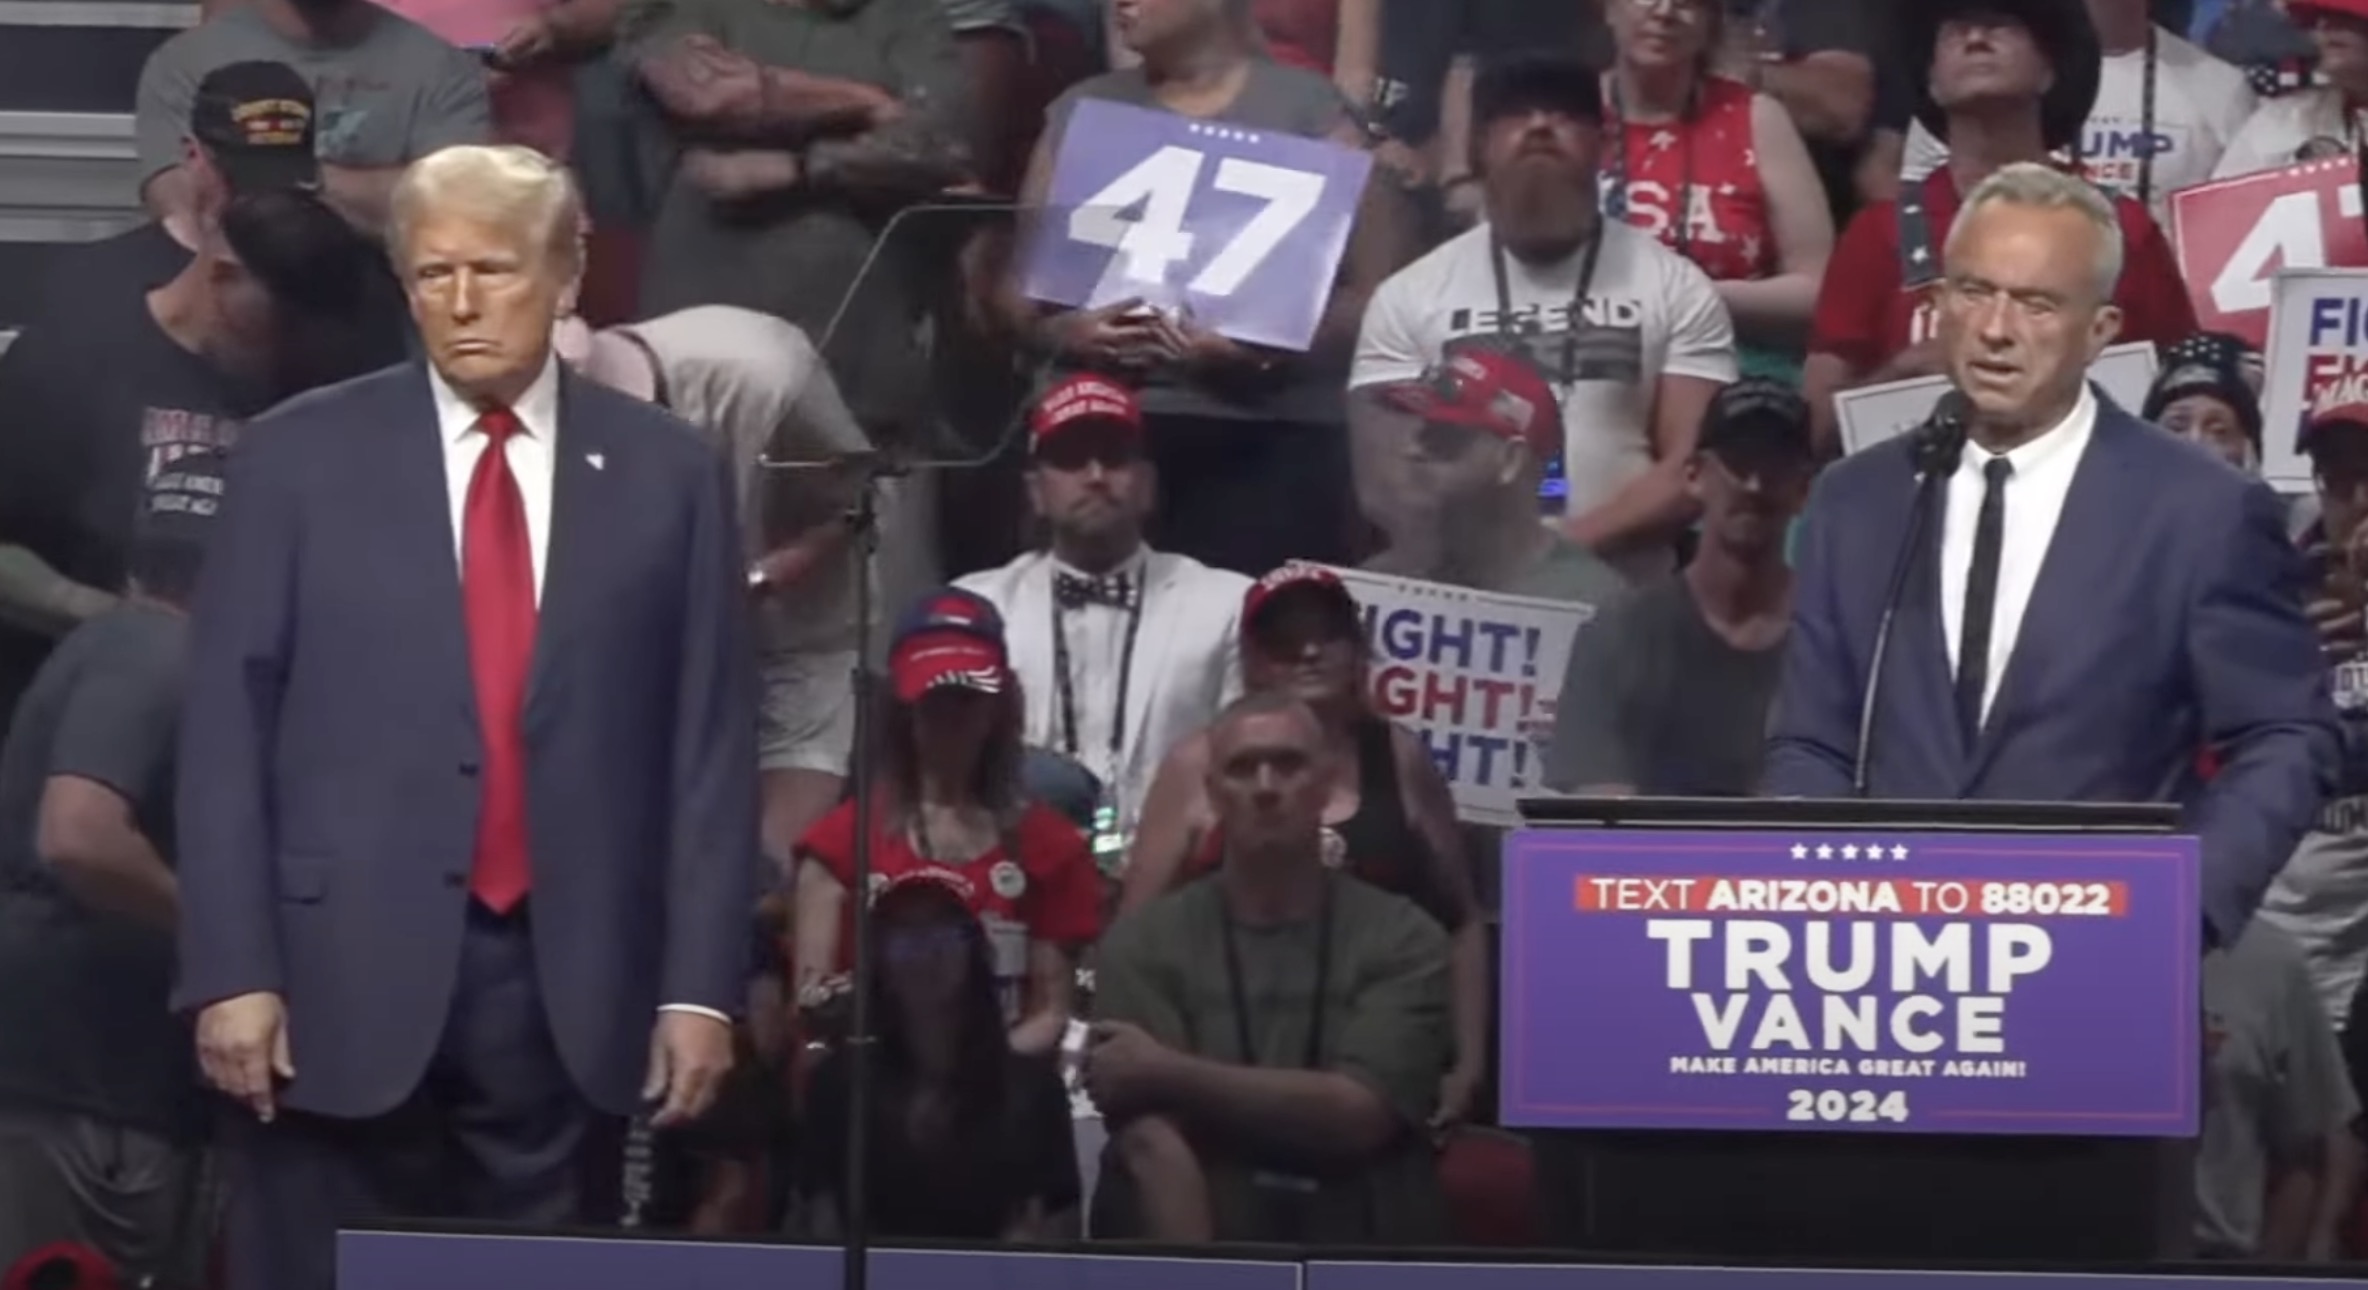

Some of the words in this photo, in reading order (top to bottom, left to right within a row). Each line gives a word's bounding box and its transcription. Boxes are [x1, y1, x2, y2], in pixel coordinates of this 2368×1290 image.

[2080, 130, 2174, 159] UMP
[1067, 145, 1327, 296] 47
[2210, 182, 2361, 313] 4
[2309, 297, 2368, 347] FI
[1366, 604, 1541, 677] IGHT!
[1374, 666, 1536, 733] GHT!
[1420, 729, 1528, 789] HT!
[1590, 878, 1696, 910] TEXT
[1706, 879, 1902, 912] ARIZONA
[1912, 881, 1969, 914] TO
[1980, 882, 2110, 915] 88022
[1646, 919, 2053, 993] TRUMP
[1690, 993, 2004, 1053] VANCE
[1670, 1057, 1737, 1074] MAKE
[1743, 1057, 1851, 1075] AMERICA
[1858, 1059, 1936, 1076] GREAT
[1942, 1060, 2027, 1077] AGAIN!
[1787, 1089, 1909, 1122] 2024
